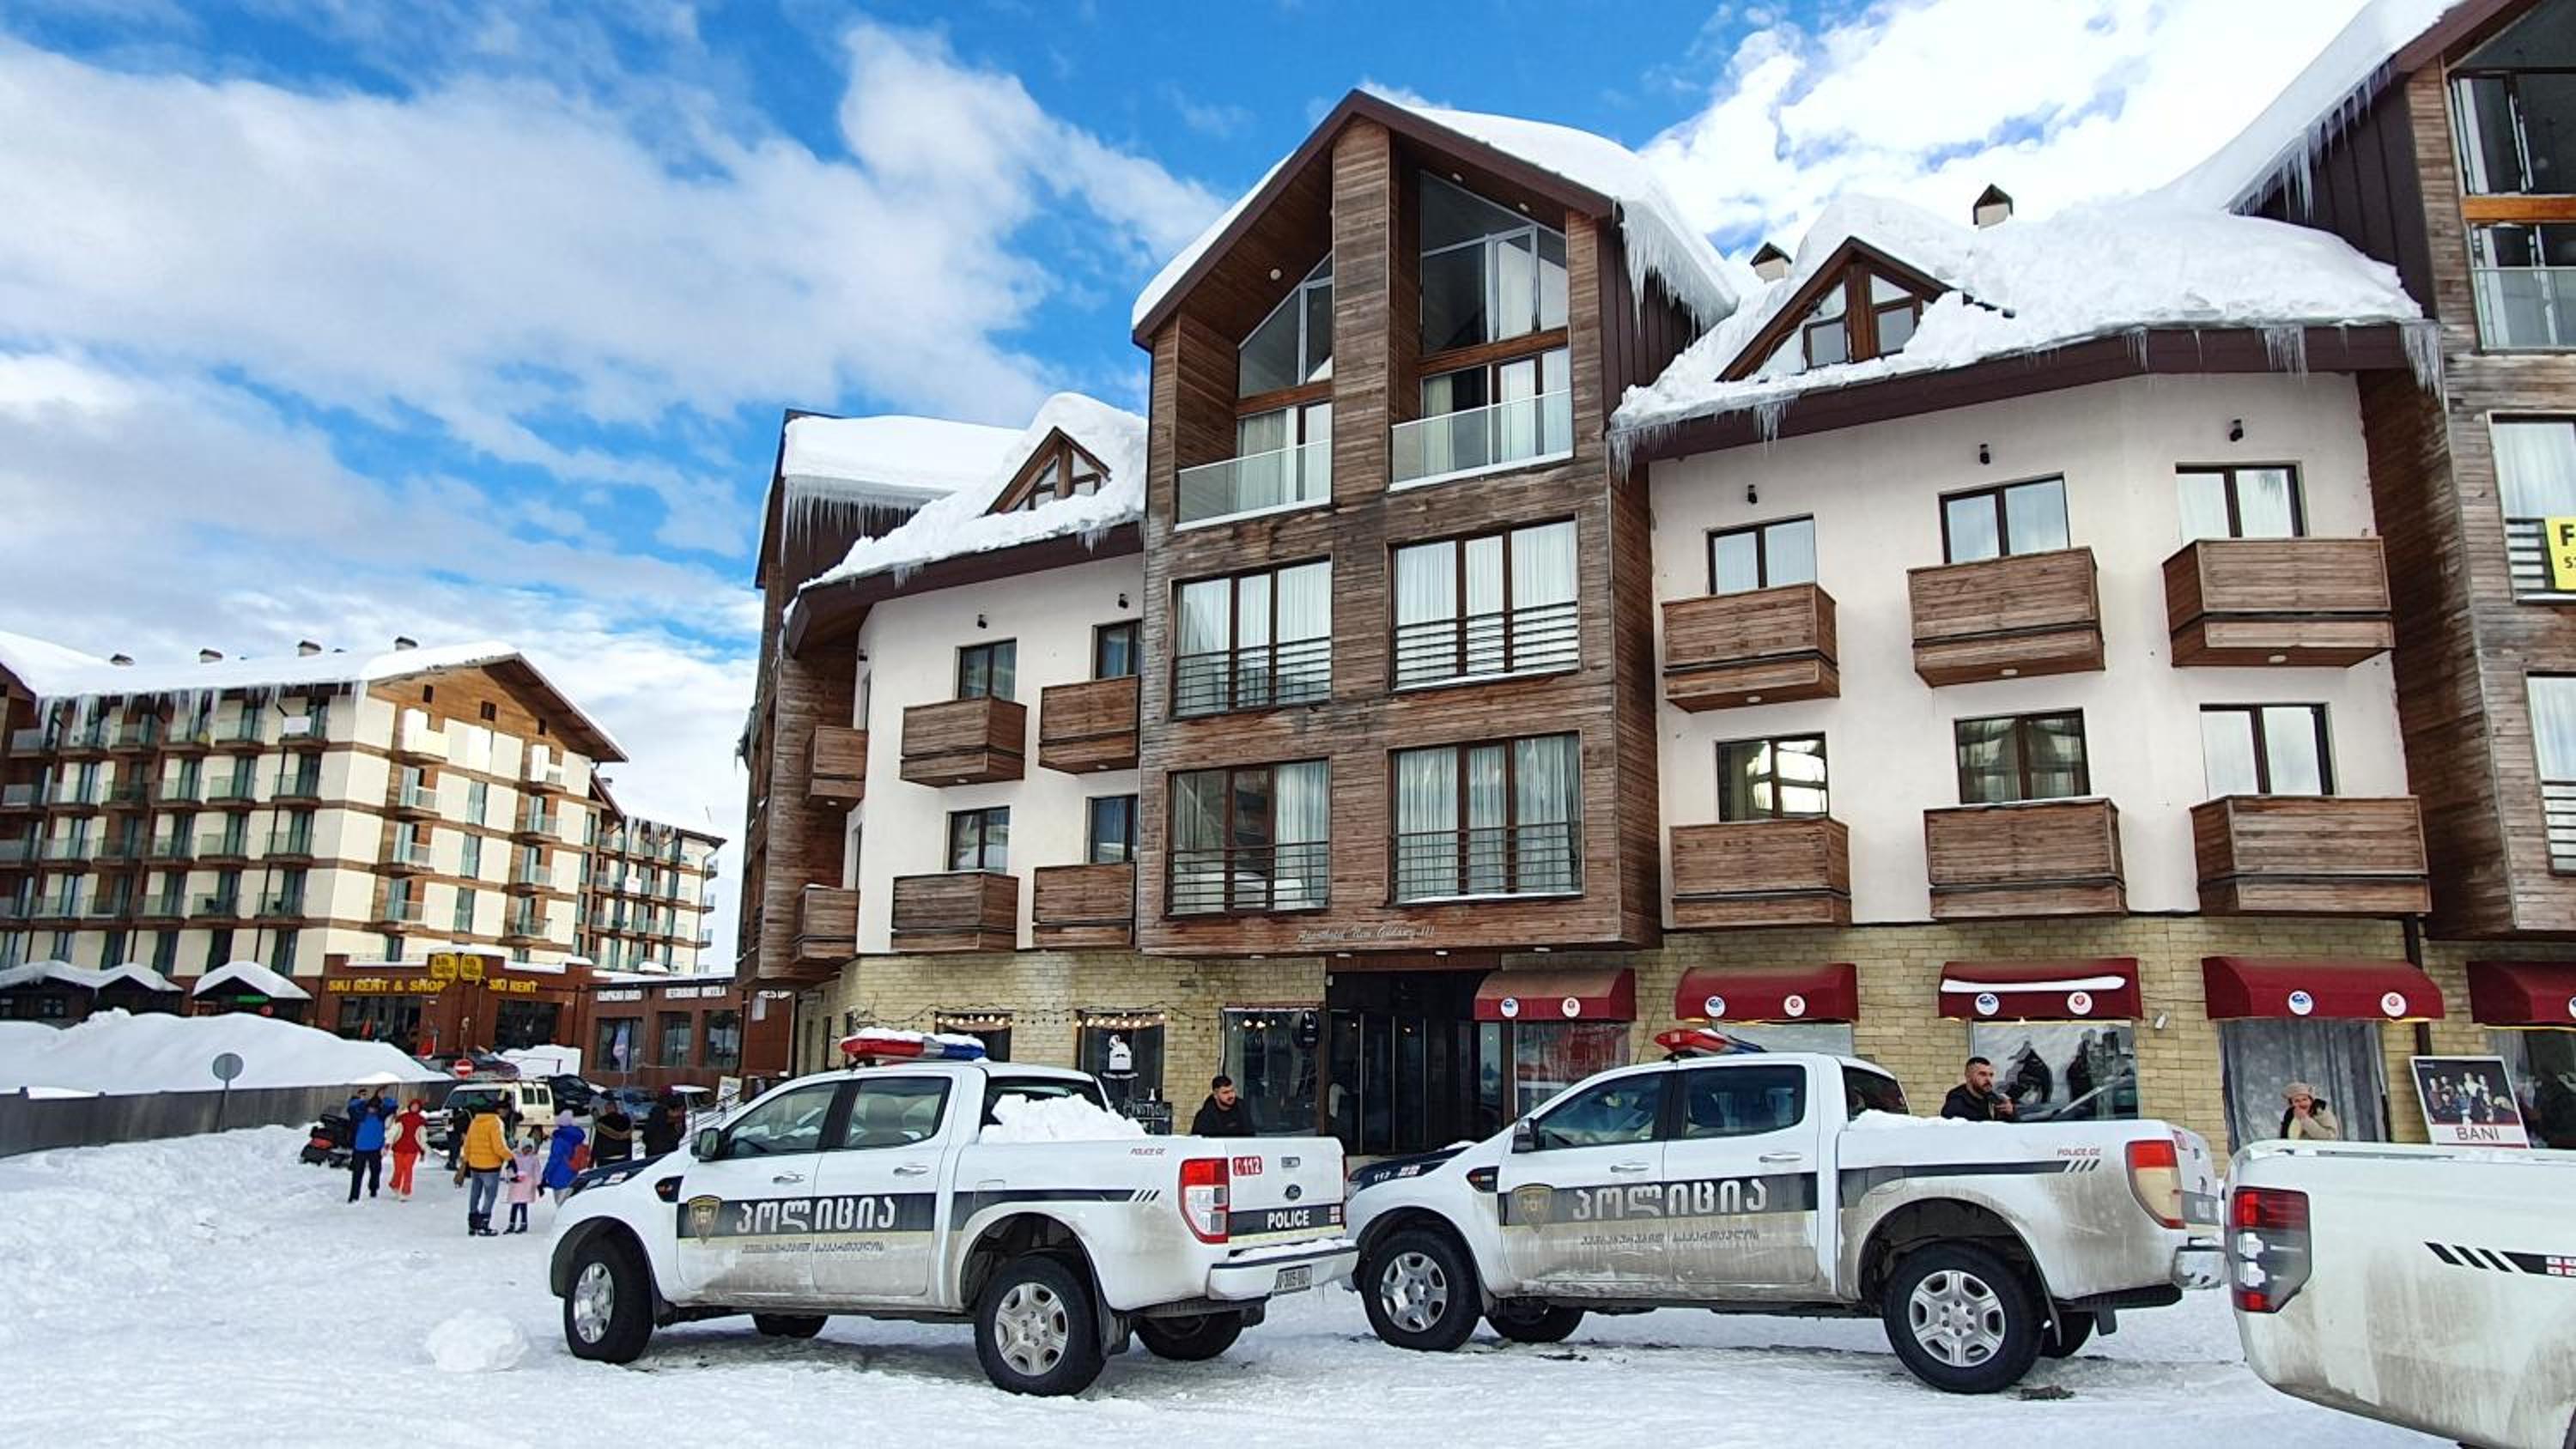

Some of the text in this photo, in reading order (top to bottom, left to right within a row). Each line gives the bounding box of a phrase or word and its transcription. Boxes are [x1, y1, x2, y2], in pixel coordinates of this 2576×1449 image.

[354, 979, 387, 992] RENT
[410, 979, 447, 992] SHOP
[2456, 1127, 2500, 1140] BANI
[1242, 1158, 1261, 1174] 112
[1573, 1178, 1767, 1221] პოლიცია
[736, 1196, 896, 1234] პოლიცია
[1267, 1210, 1309, 1229] POLICE
